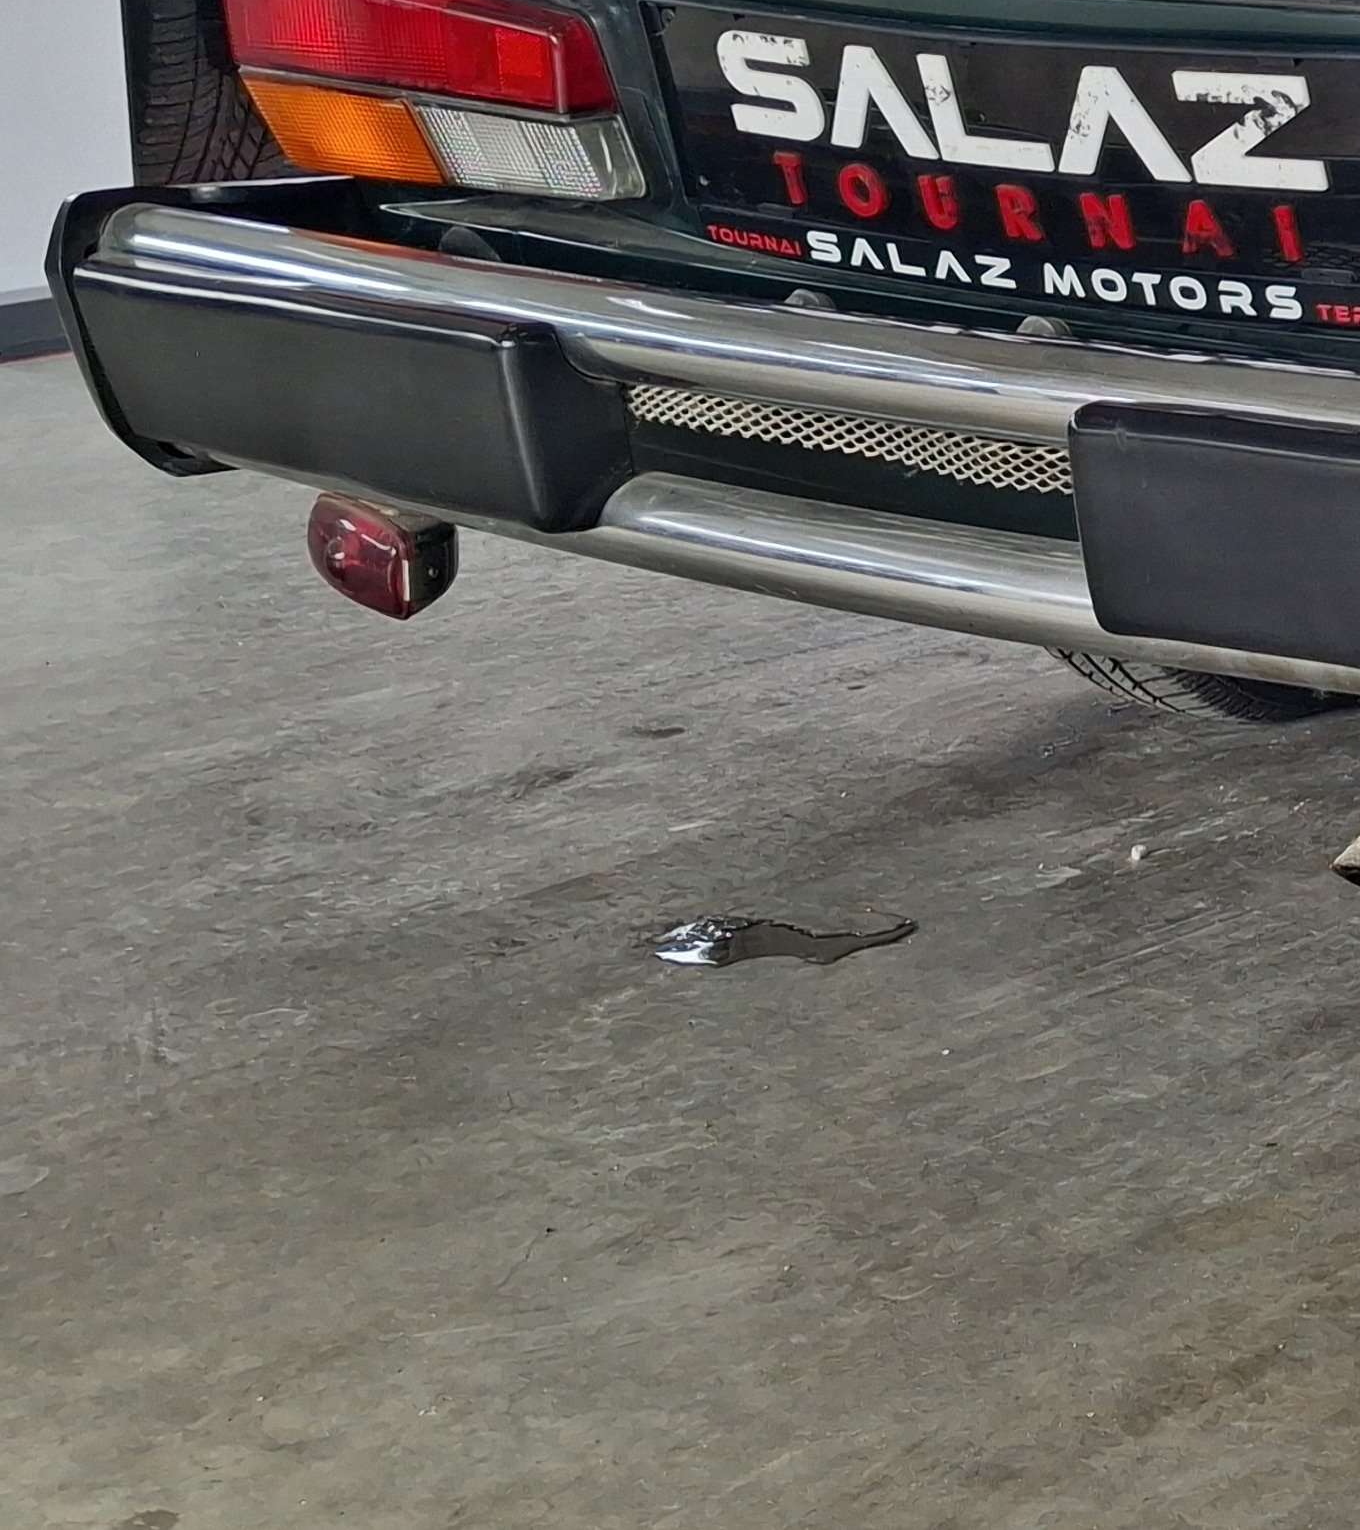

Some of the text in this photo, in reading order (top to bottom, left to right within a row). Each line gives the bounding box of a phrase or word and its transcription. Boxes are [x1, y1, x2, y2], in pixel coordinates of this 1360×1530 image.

[716, 29, 1329, 191] SALAZ
[772, 150, 1304, 262] TOURNAI
[706, 224, 802, 257] TOURNAI
[806, 230, 1018, 289] SALAZ
[1043, 262, 1304, 321] MOTORS
